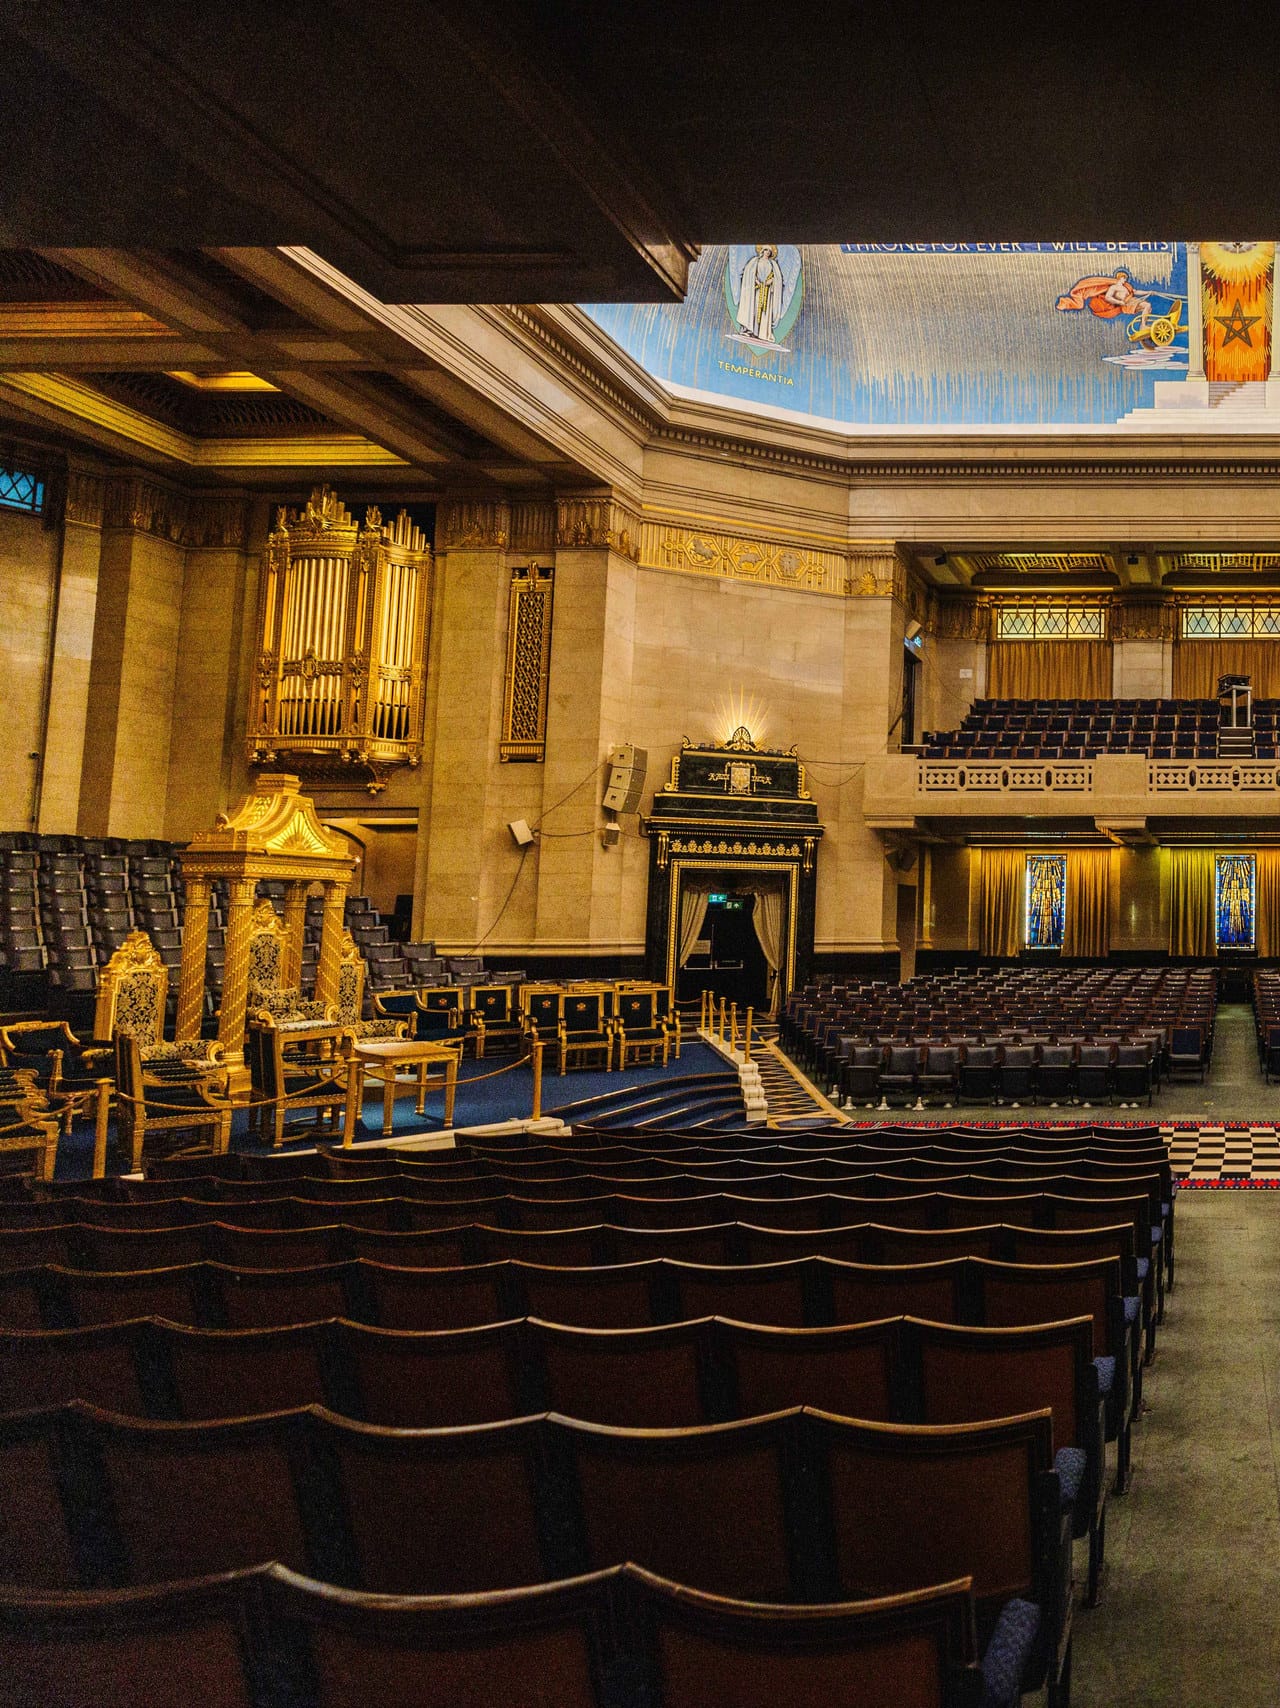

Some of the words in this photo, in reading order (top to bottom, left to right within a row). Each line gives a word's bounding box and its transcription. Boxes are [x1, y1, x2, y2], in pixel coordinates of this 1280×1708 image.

[976, 243, 1022, 252] EVER
[1052, 242, 1098, 251] WILL
[1106, 242, 1129, 251] BE
[1139, 241, 1169, 251] HIS
[718, 360, 794, 386] TEMPERANTIA
